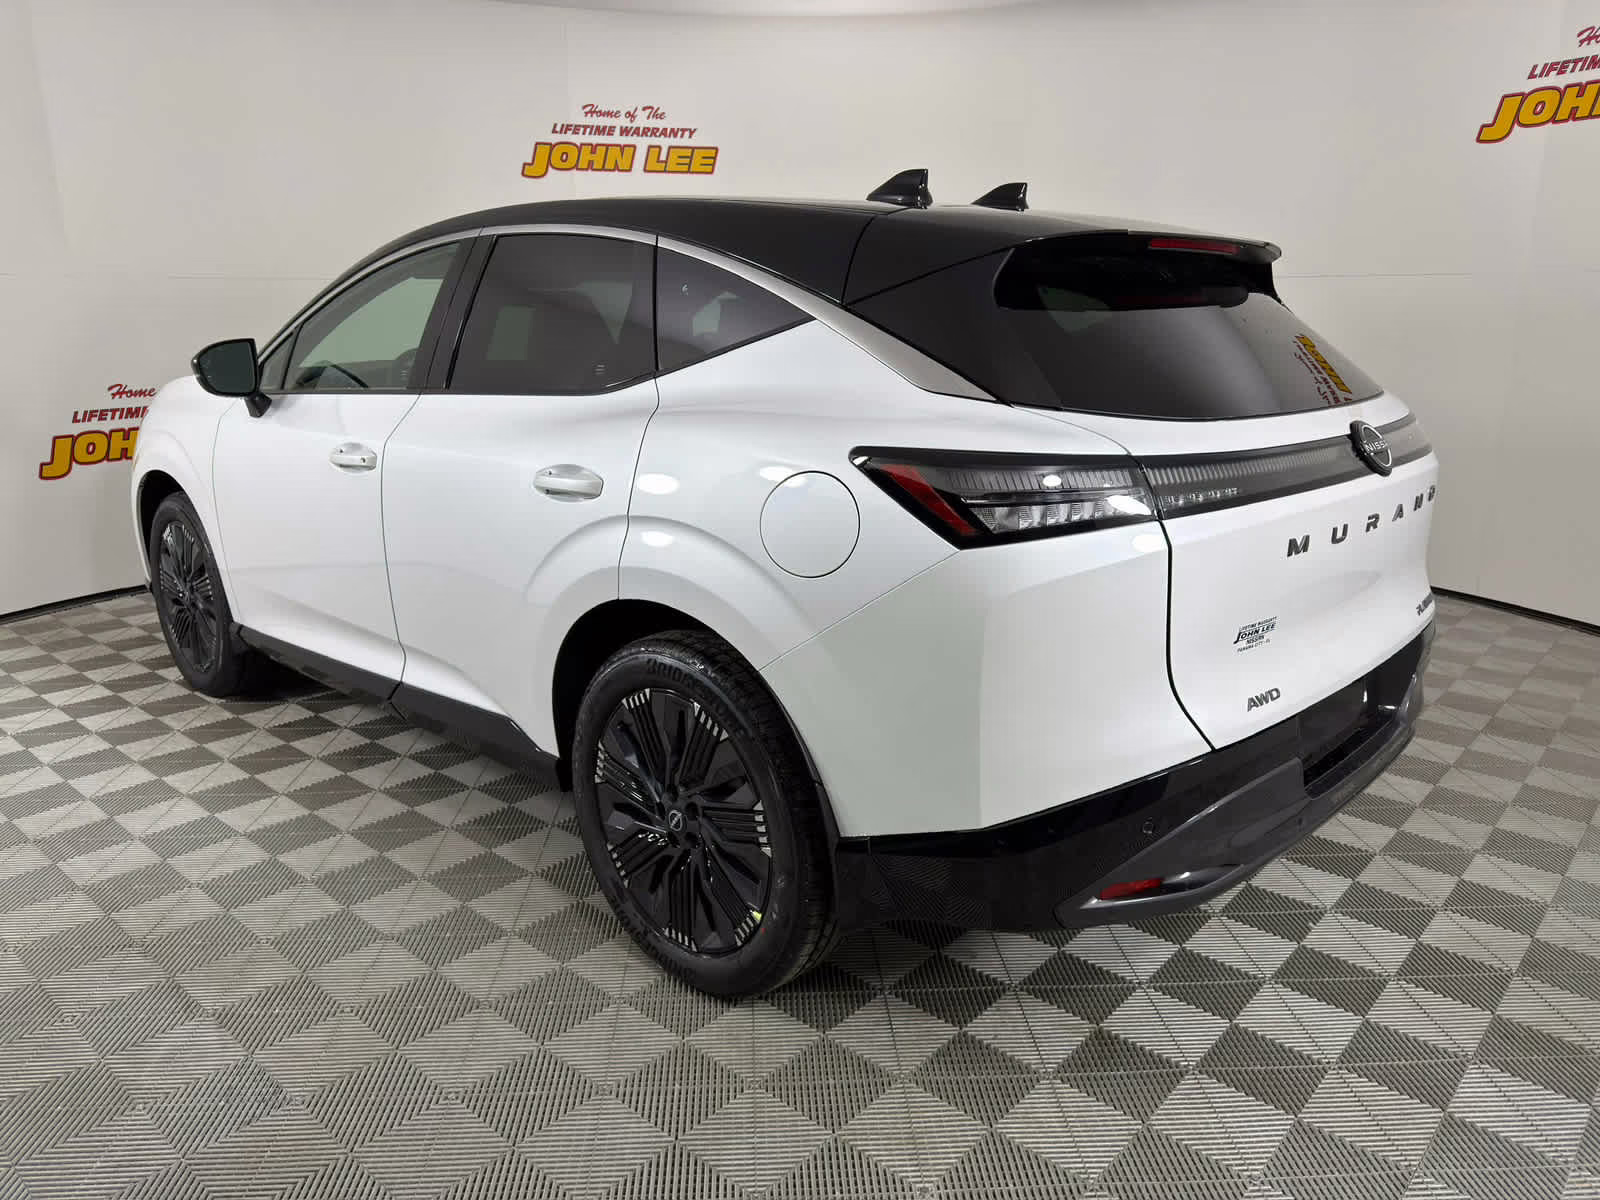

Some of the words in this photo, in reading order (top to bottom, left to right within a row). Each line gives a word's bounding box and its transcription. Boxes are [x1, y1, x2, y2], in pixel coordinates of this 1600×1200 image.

[582, 103, 621, 119] Home
[625, 107, 638, 123] of
[642, 105, 666, 120] The
[1476, 79, 1600, 144] JOH
[551, 123, 616, 137] LIFETIME
[619, 125, 697, 139] WARRANTY
[521, 141, 637, 179] JOHN
[643, 145, 719, 175] LEE
[107, 383, 157, 400] Home
[1233, 629, 1260, 644] JOHN
[1261, 623, 1277, 633] LEE
[1247, 687, 1281, 712] AWD
